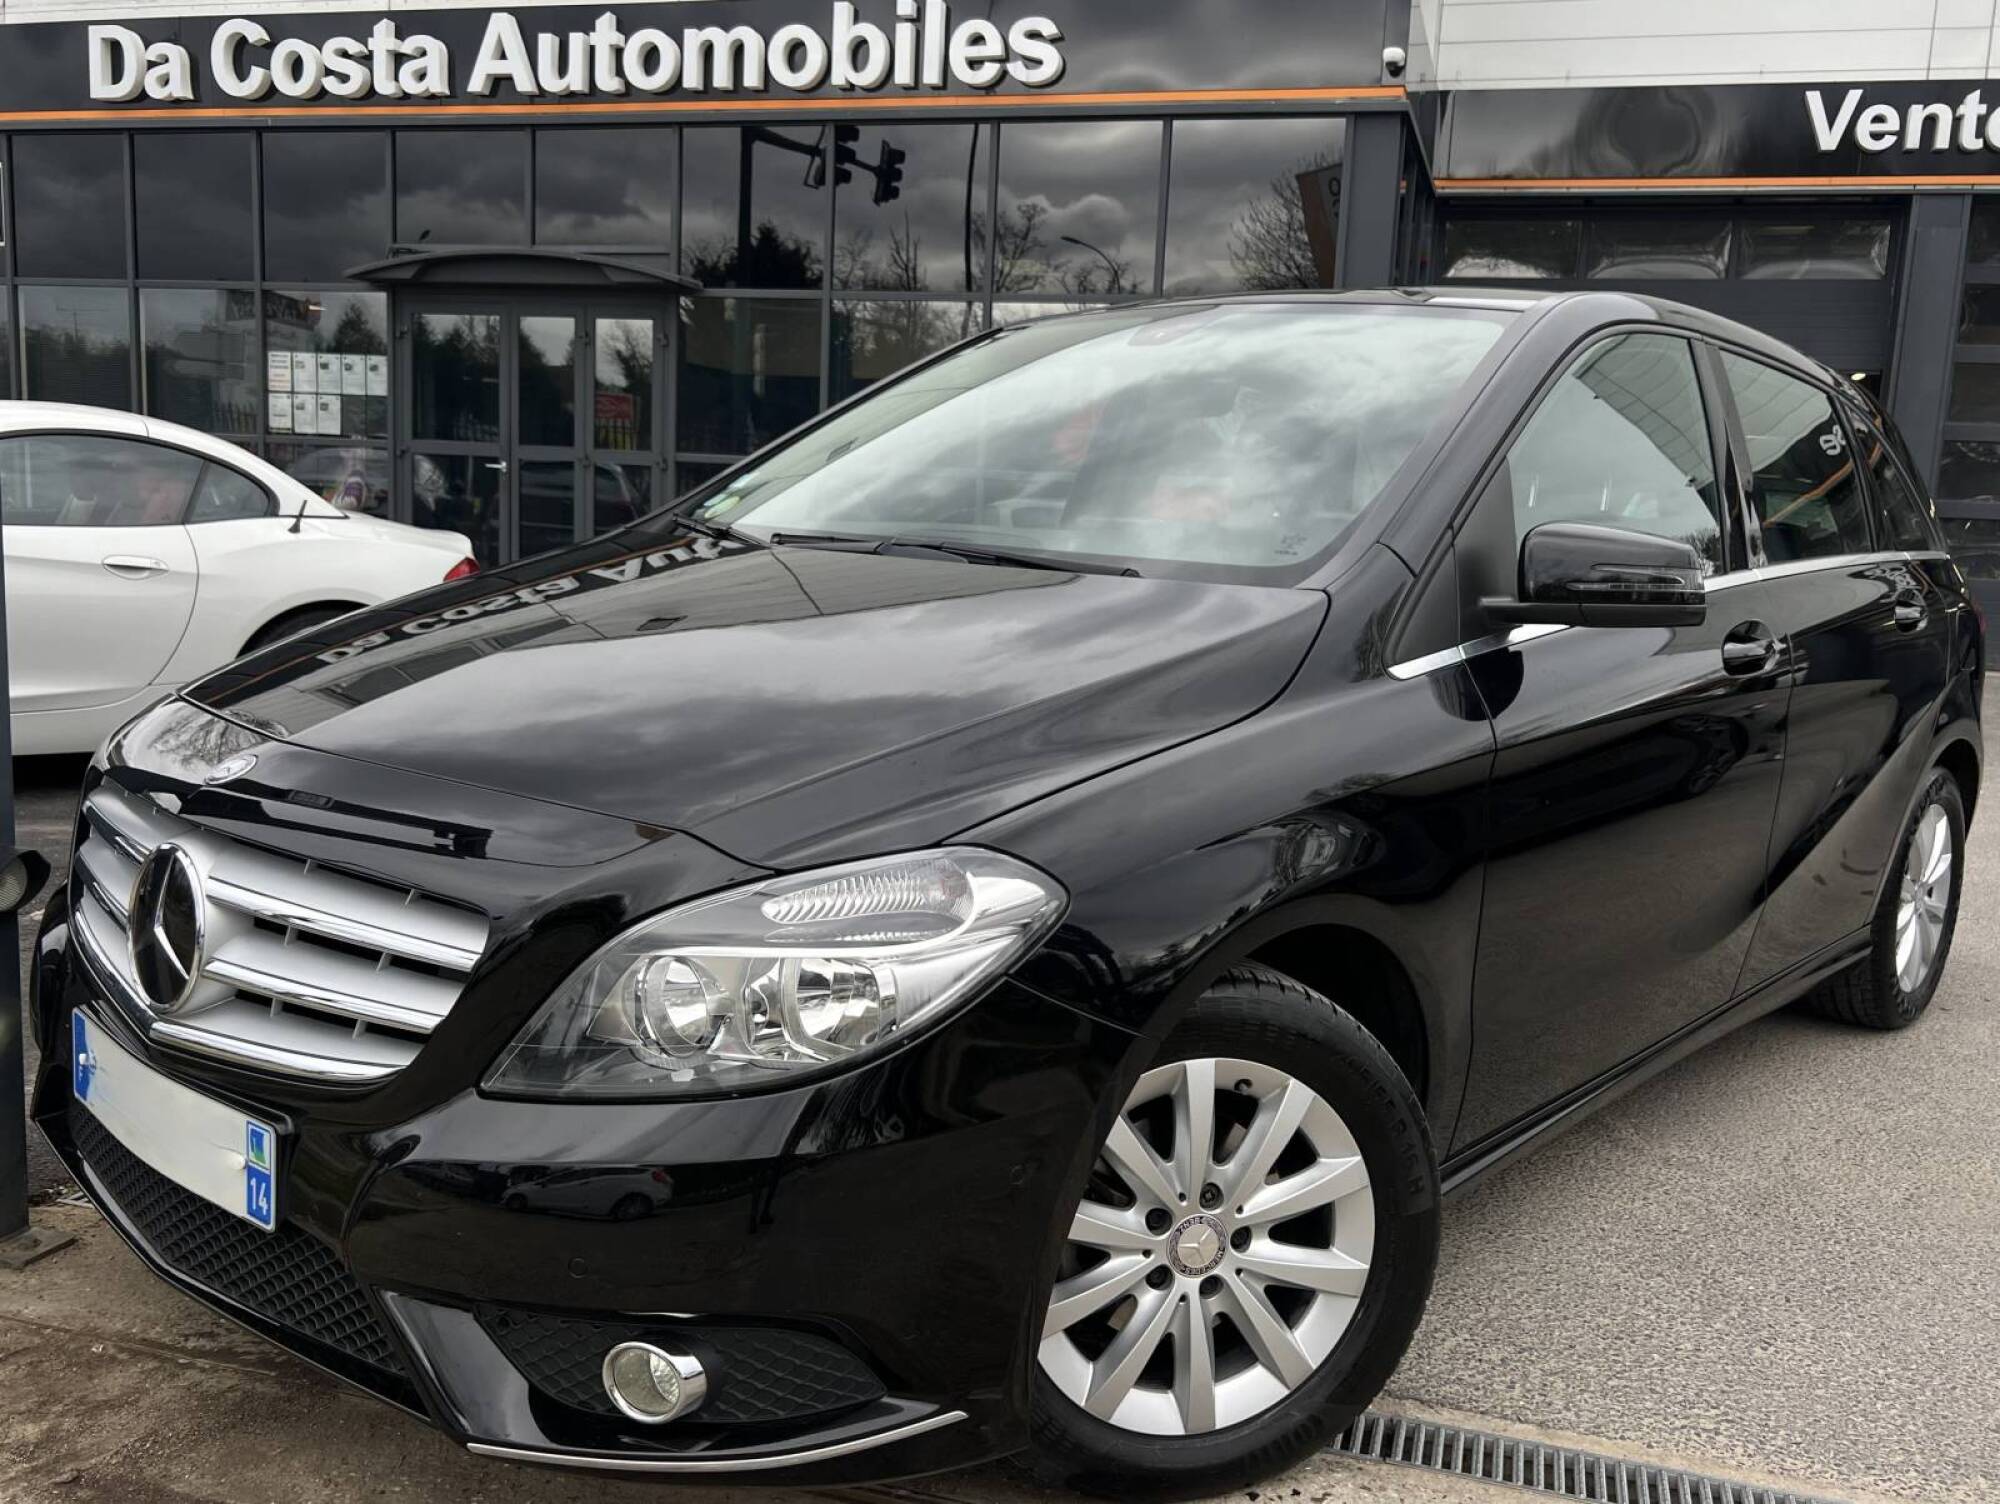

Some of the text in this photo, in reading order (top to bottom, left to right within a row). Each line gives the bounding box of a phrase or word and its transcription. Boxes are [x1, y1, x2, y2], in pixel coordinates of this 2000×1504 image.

[88, 0, 1064, 101] Da Costa Automobiles
[250, 1176, 269, 1216] 14
